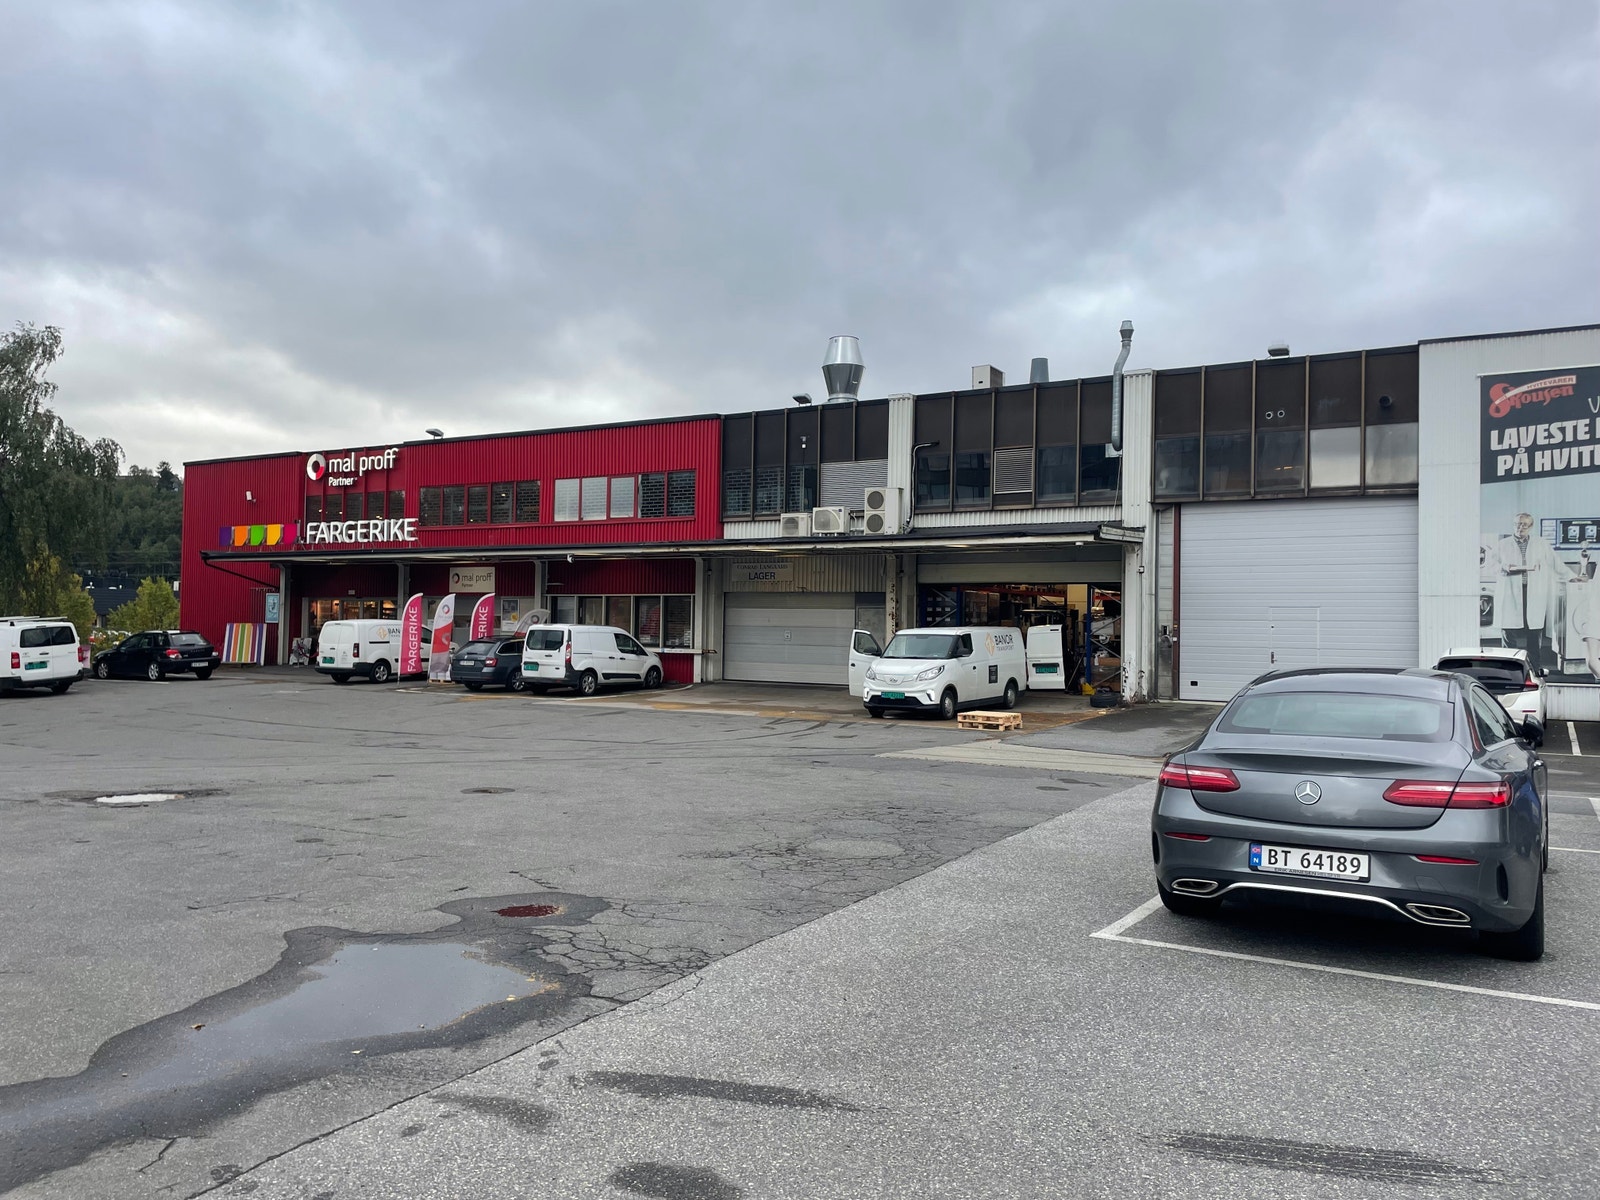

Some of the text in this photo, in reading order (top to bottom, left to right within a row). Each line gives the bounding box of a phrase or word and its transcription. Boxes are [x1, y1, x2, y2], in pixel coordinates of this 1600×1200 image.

[1490, 419, 1590, 451] LAVESTE
[328, 447, 399, 477] mal proff
[1497, 447, 1529, 476] PÅ
[328, 476, 354, 487] Partner
[306, 518, 419, 544] FARGERIKE
[461, 572, 493, 583] mal proff
[748, 571, 776, 580] LAGER
[478, 606, 489, 639] ERIKE
[407, 605, 418, 672] FARGERIKE
[994, 634, 1014, 646] BANOR
[1267, 848, 1361, 874] BT 64189
